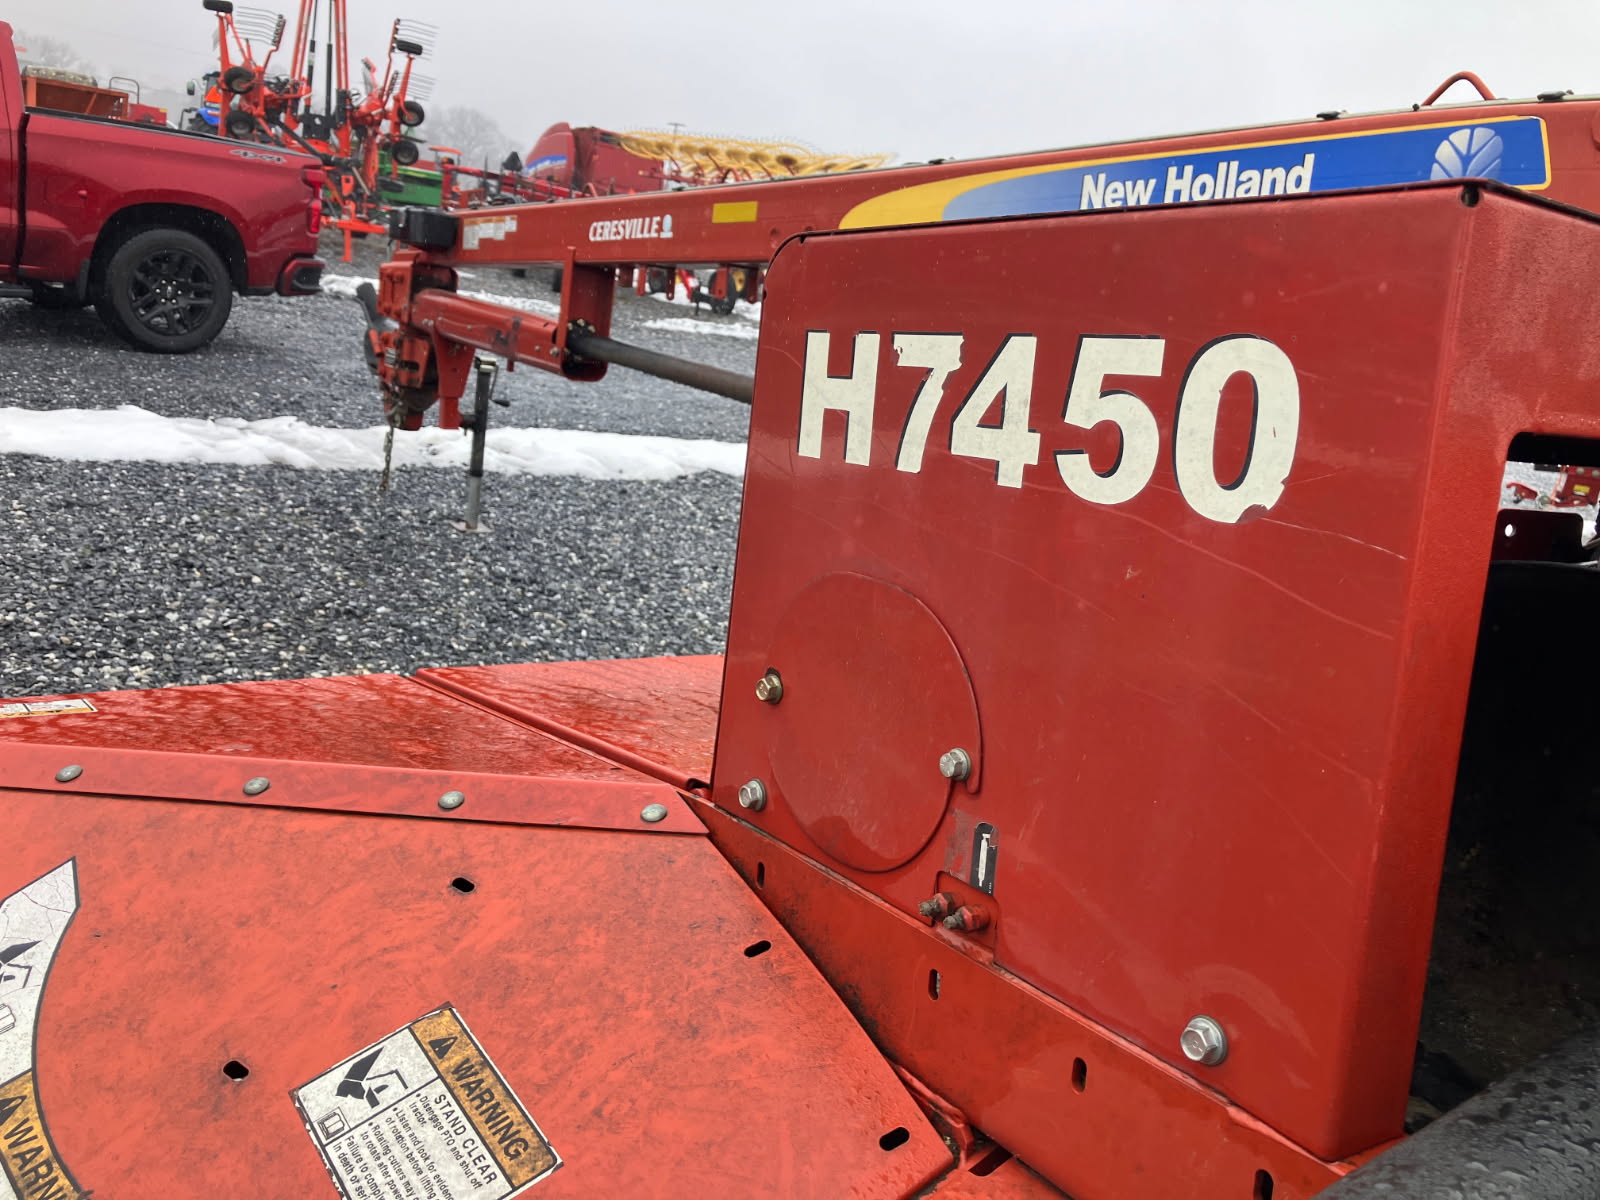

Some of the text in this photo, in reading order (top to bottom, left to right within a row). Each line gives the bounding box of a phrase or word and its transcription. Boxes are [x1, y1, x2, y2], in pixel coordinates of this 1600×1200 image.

[1079, 153, 1315, 210] New Holland
[588, 216, 661, 242] CERESVILLE
[797, 329, 1300, 524] H7450
[396, 1110, 412, 1133] Listen
[409, 1131, 421, 1146] and
[416, 1145, 430, 1162] look
[426, 1161, 436, 1173] for
[419, 1095, 483, 1189] Disengage PTO and shut off
[434, 1094, 498, 1184] STAND CLEAR
[451, 1058, 529, 1160] WARNING
[338, 1152, 355, 1175] death
[350, 1175, 360, 1184] or
[344, 1135, 363, 1163] Failure
[359, 1162, 368, 1172] to
[360, 1131, 369, 1140] to
[366, 1141, 381, 1161] rotate
[377, 1162, 391, 1179] after
[371, 1124, 416, 1198] Rotating cutters may
[385, 1117, 436, 1200] of rotation before lifting
